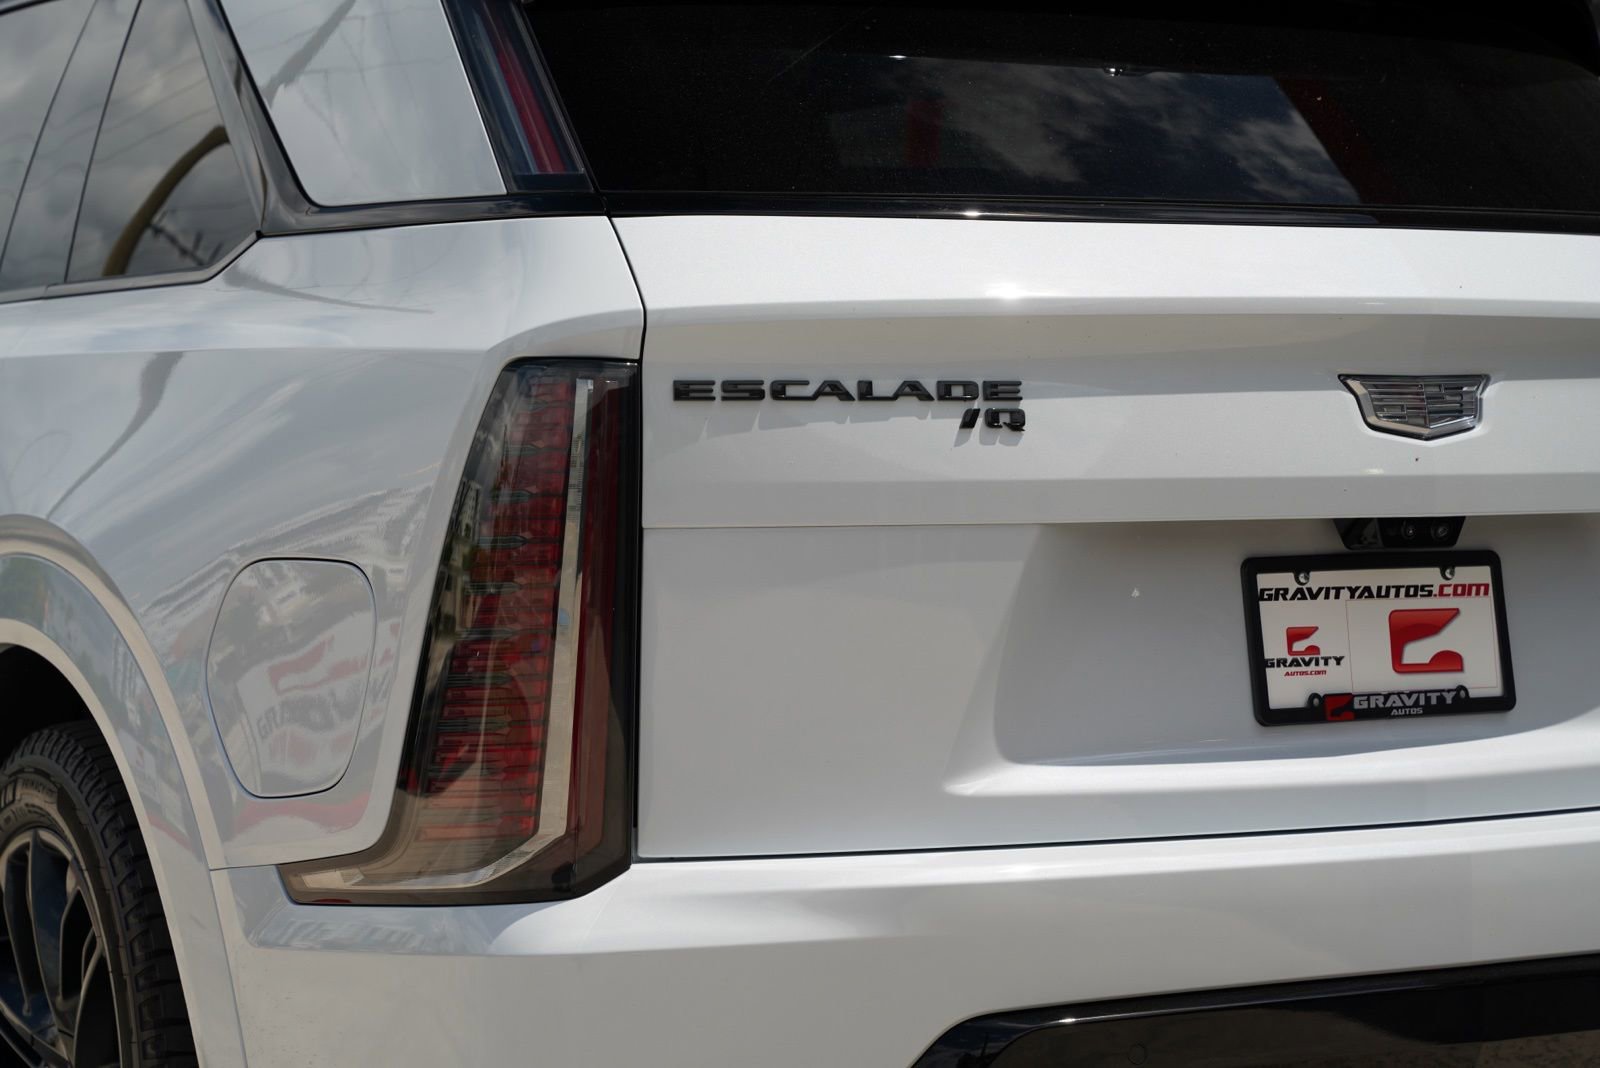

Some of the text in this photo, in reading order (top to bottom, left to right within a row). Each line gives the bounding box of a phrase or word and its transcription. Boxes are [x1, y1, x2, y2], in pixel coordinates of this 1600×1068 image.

[673, 380, 1023, 401] ESCALADE
[959, 407, 1026, 431] IQ
[1259, 583, 1490, 601] GRAVITYAUTOS.COM
[1265, 655, 1345, 668] GRAVITY
[1353, 690, 1457, 709] GRAVITY
[1390, 707, 1423, 716] AUTOS
